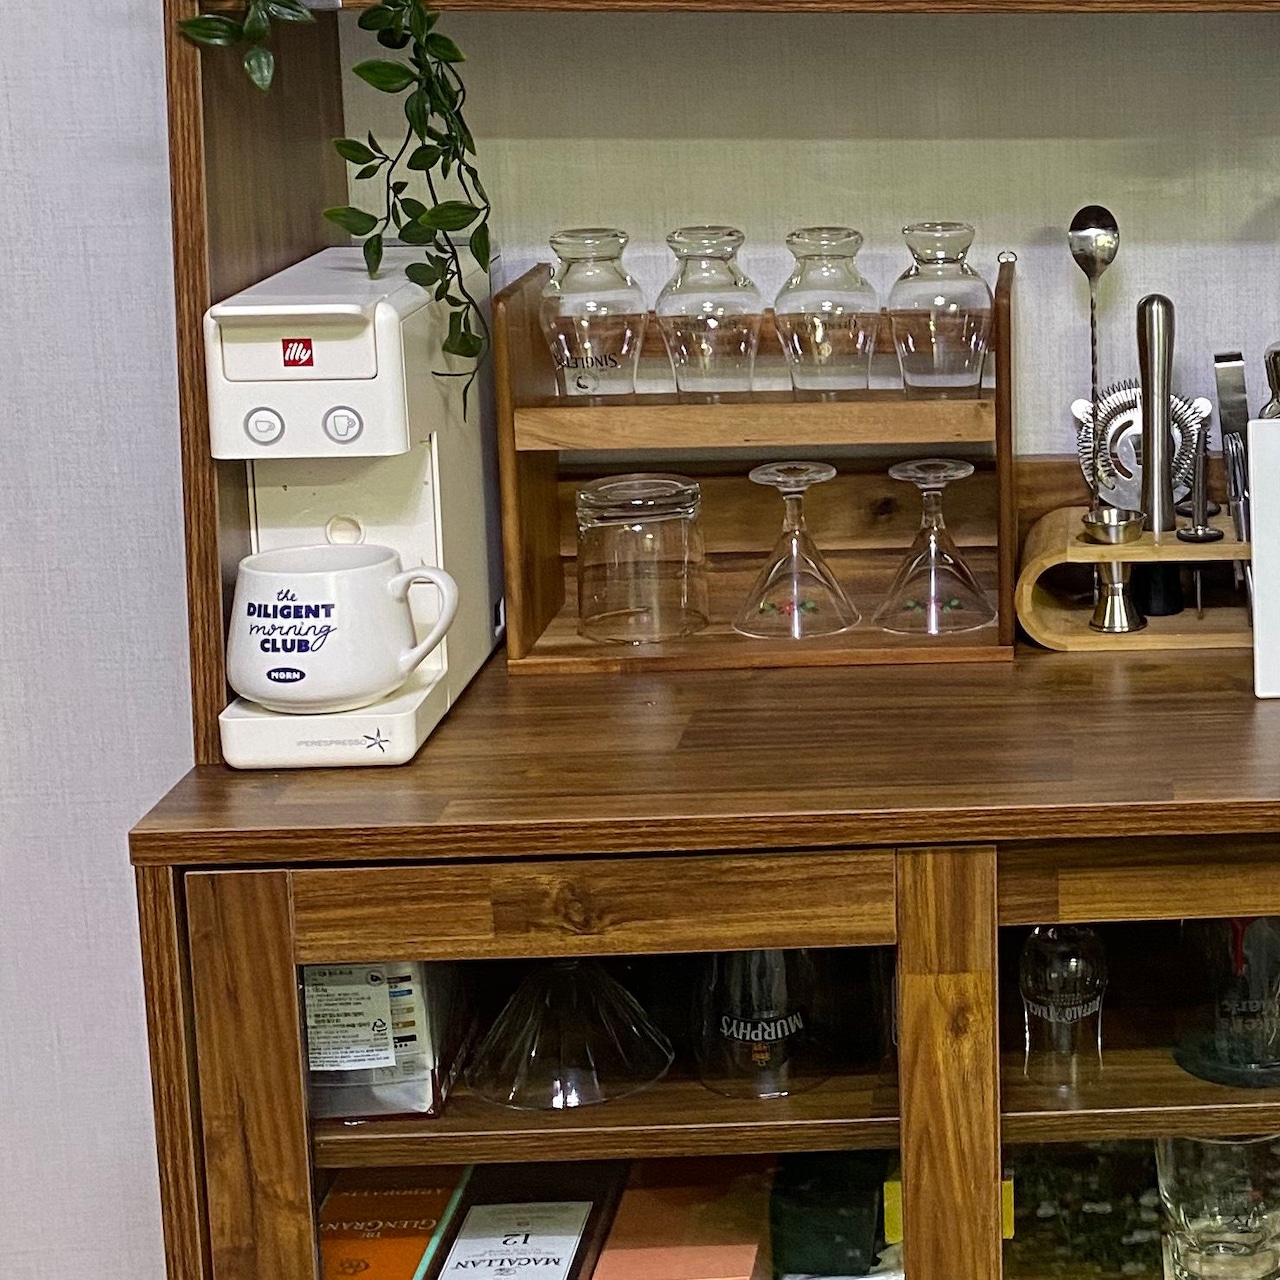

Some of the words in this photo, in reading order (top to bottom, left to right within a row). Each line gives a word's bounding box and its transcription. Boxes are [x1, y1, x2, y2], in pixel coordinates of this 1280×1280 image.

[284, 342, 312, 365] illy
[276, 588, 298, 603] the
[247, 602, 335, 620] DILIGENT
[248, 622, 338, 652] morning
[259, 637, 310, 653] CLUB
[502, 1232, 532, 1247] 12
[450, 1256, 564, 1271] MACALLAN
